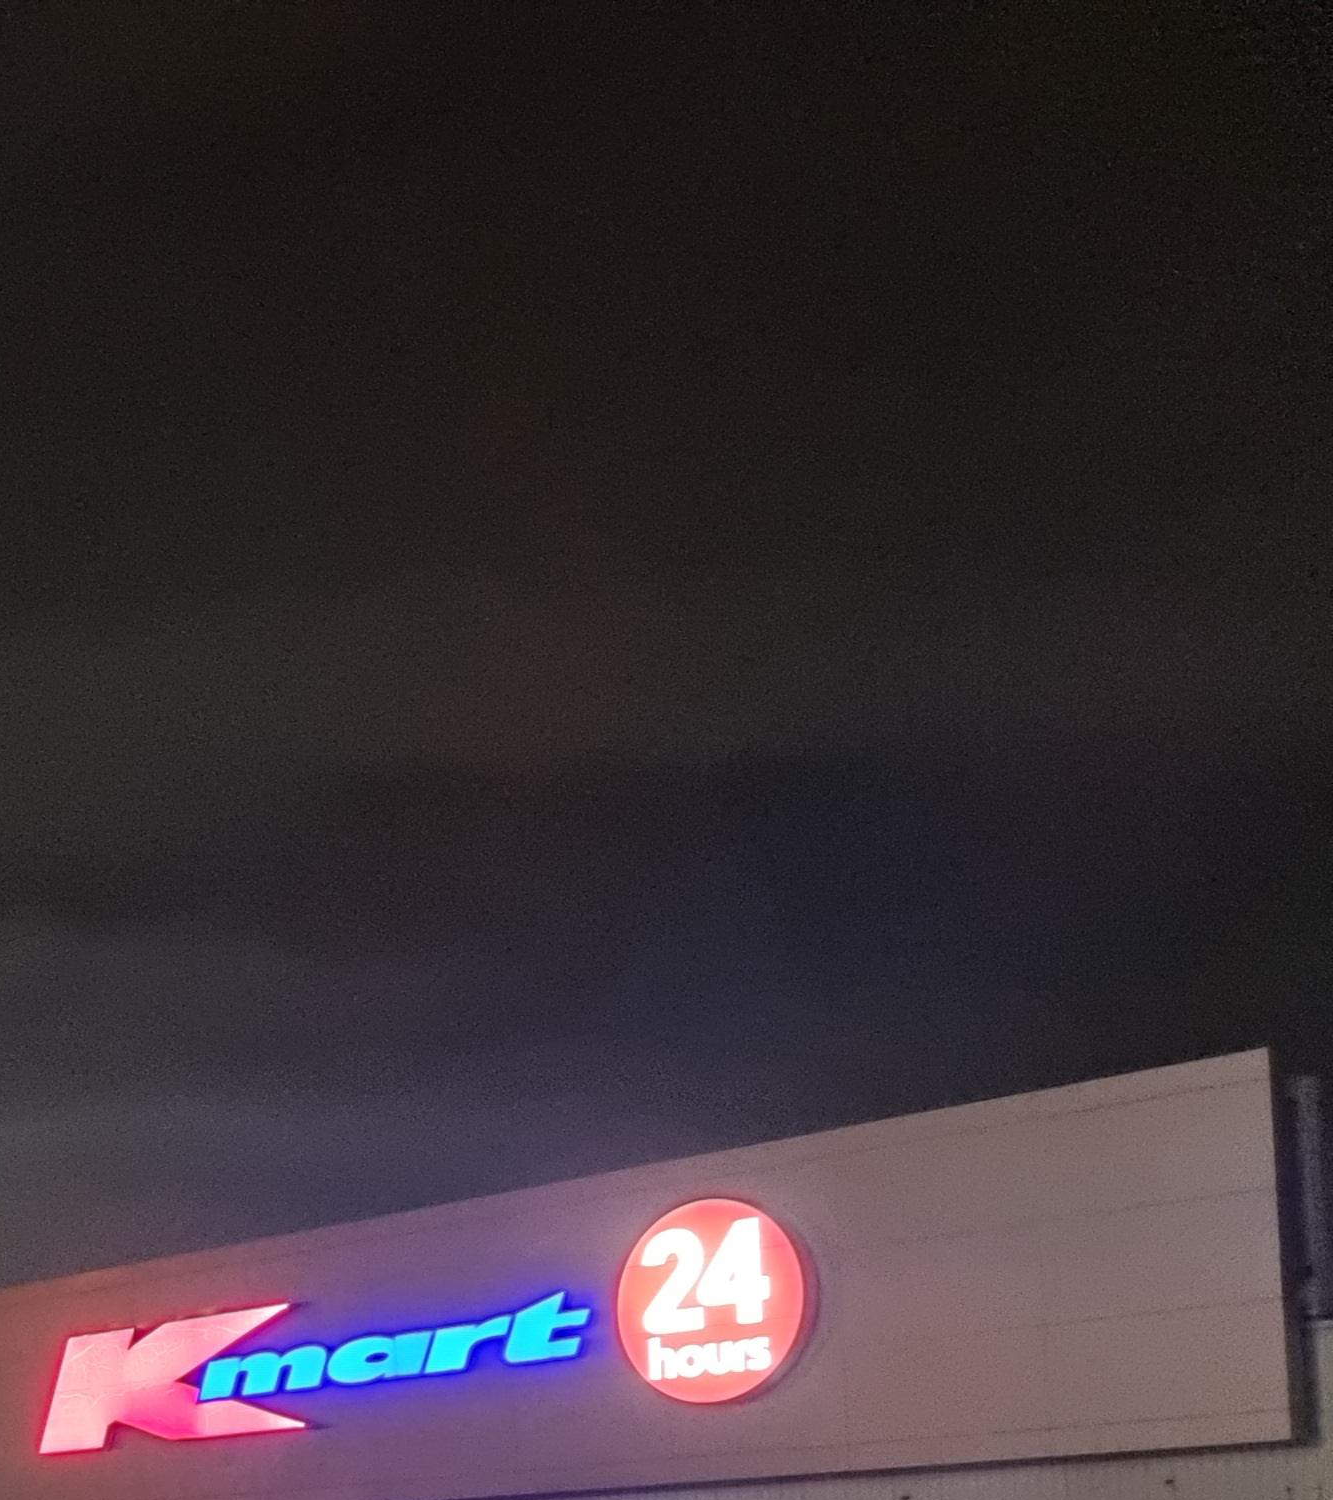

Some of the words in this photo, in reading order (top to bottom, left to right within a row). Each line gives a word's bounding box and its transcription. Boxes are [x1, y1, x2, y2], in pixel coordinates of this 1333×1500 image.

[641, 1216, 771, 1335] 24
[39, 1291, 591, 1455] Kmart
[647, 1336, 772, 1381] hours
